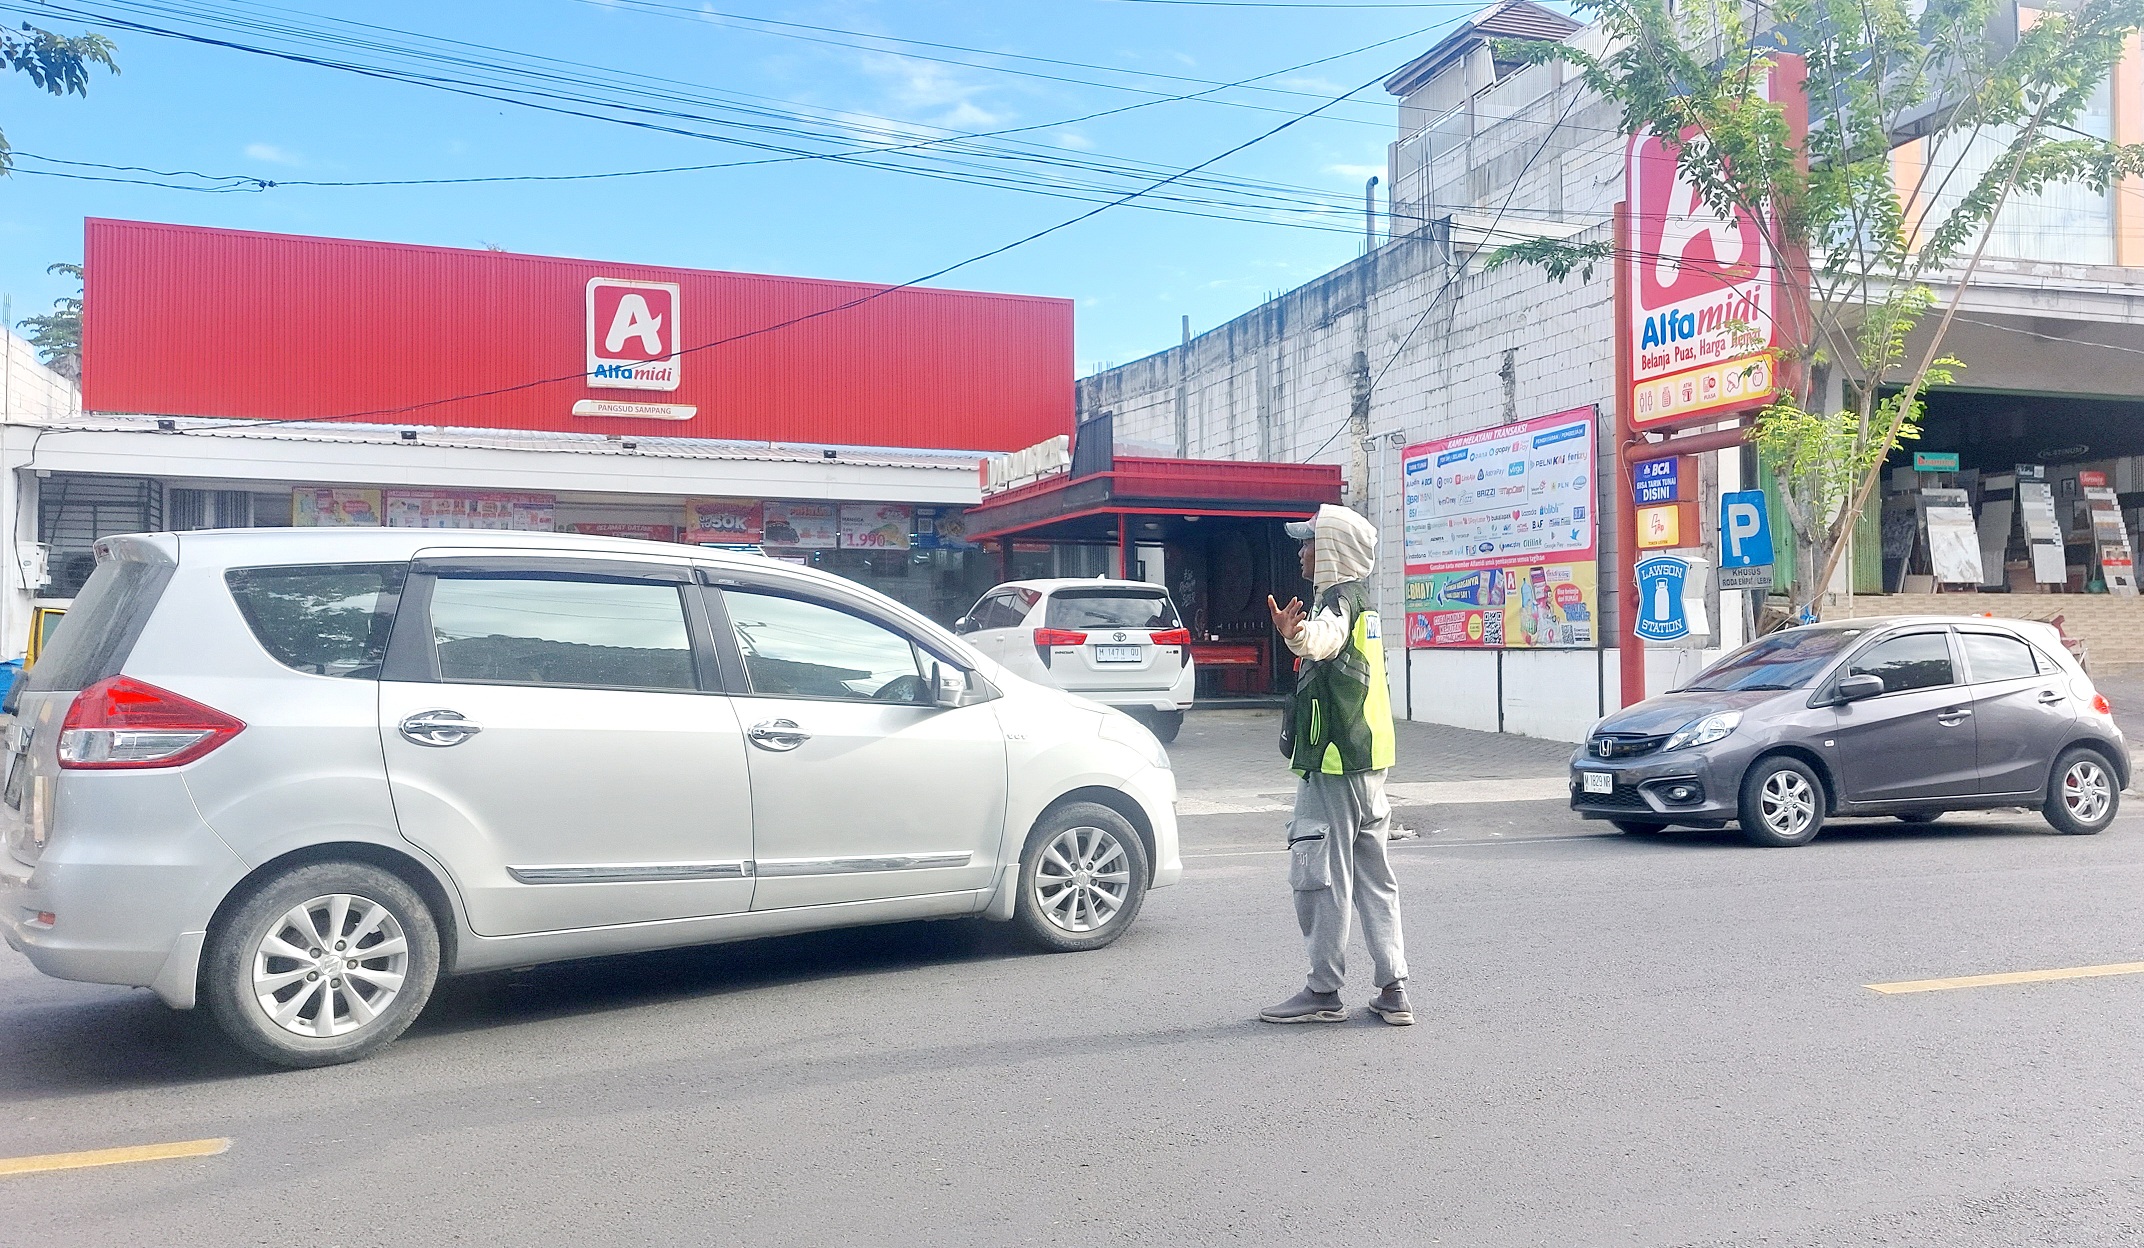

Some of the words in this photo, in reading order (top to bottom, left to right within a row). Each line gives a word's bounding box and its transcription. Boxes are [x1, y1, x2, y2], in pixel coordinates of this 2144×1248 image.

[605, 294, 662, 355] A
[1641, 285, 1762, 351] Alfamidi
[1641, 349, 1670, 371] Belanja
[1675, 346, 1696, 362] Puas,
[1699, 338, 1726, 357] Harga
[594, 364, 672, 382] Alfamidi
[597, 404, 633, 413] PANGSUD
[635, 405, 671, 415] SAMPANG
[1447, 438, 1462, 449] KAMI
[1462, 431, 1493, 446] MELAYANI
[1493, 423, 1528, 440] TRANSAKSI
[1535, 459, 1552, 467] PELNI
[1552, 455, 1566, 466] KAI
[1509, 463, 1523, 474] virgo
[1652, 462, 1670, 476] BCA
[1637, 481, 1648, 490] BISA
[1648, 479, 1662, 488] TARIK
[1662, 477, 1676, 486] TUNAI
[1477, 488, 1496, 498] BRIZZI
[1643, 486, 1670, 501] DISINI
[711, 514, 749, 530] 50K
[1728, 503, 1760, 557] P
[847, 533, 886, 547] 1.990
[1641, 565, 1683, 580] LAWSON
[1732, 568, 1762, 576] KHUSUS
[1722, 578, 1737, 586] RODA
[1563, 602, 1587, 613] GRATIS
[1566, 611, 1591, 622] ONGKIR
[1641, 617, 1683, 633] STATION
